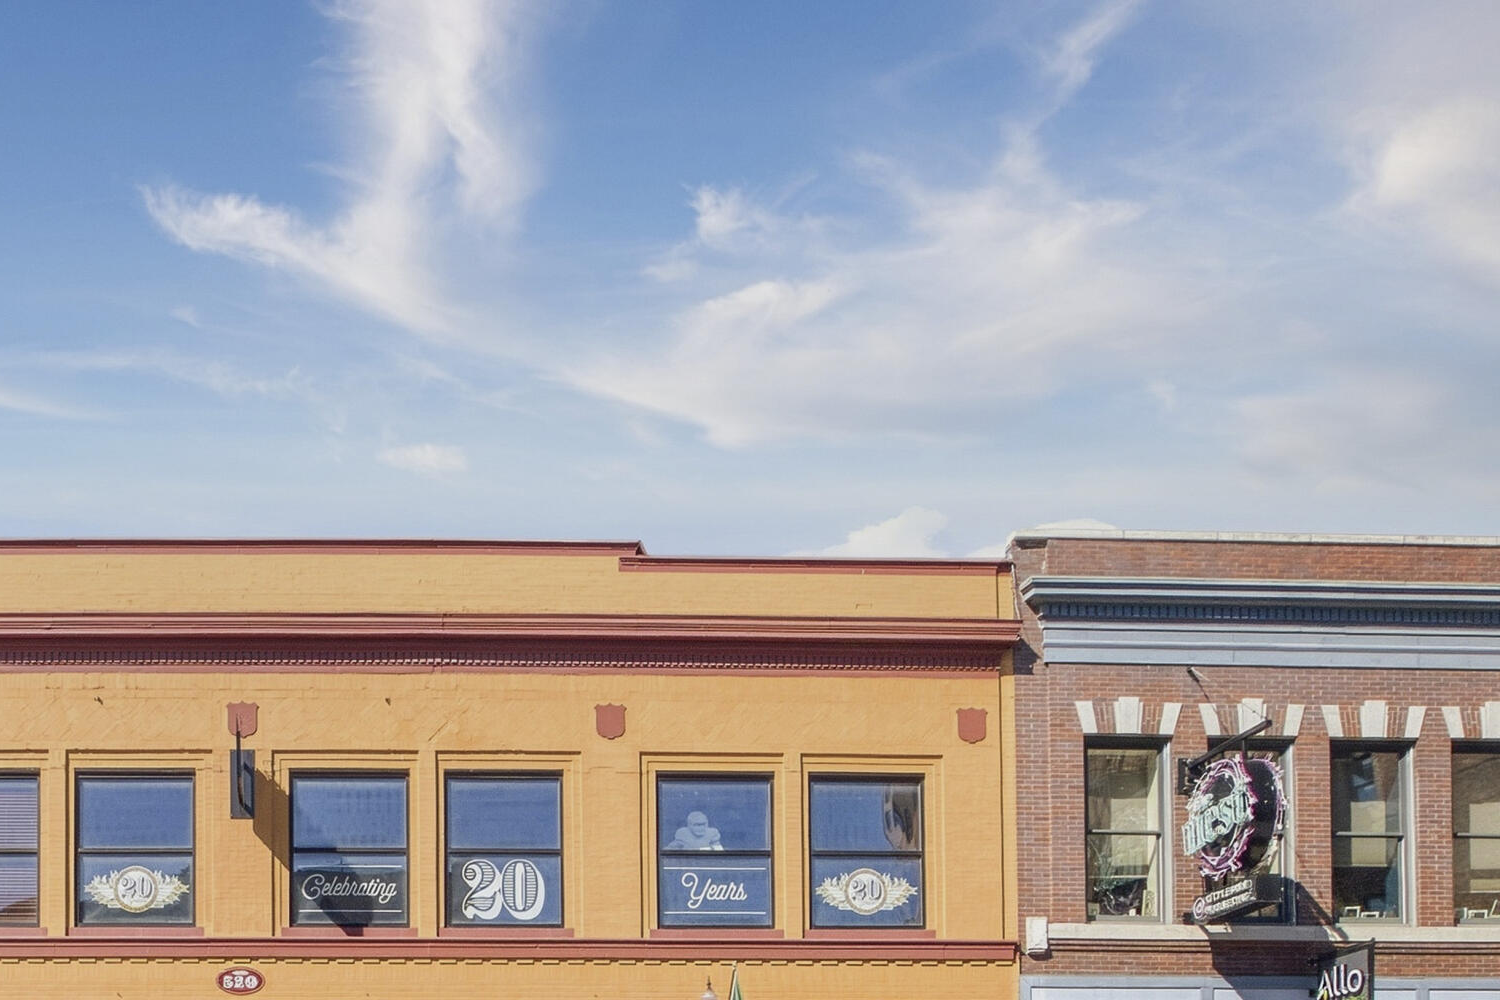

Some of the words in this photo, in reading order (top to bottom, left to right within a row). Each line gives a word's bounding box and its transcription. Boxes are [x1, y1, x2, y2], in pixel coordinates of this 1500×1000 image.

[302, 873, 398, 904] Celebrating
[462, 858, 545, 920] 20
[681, 871, 747, 910] Years
[222, 975, 259, 989] 520
